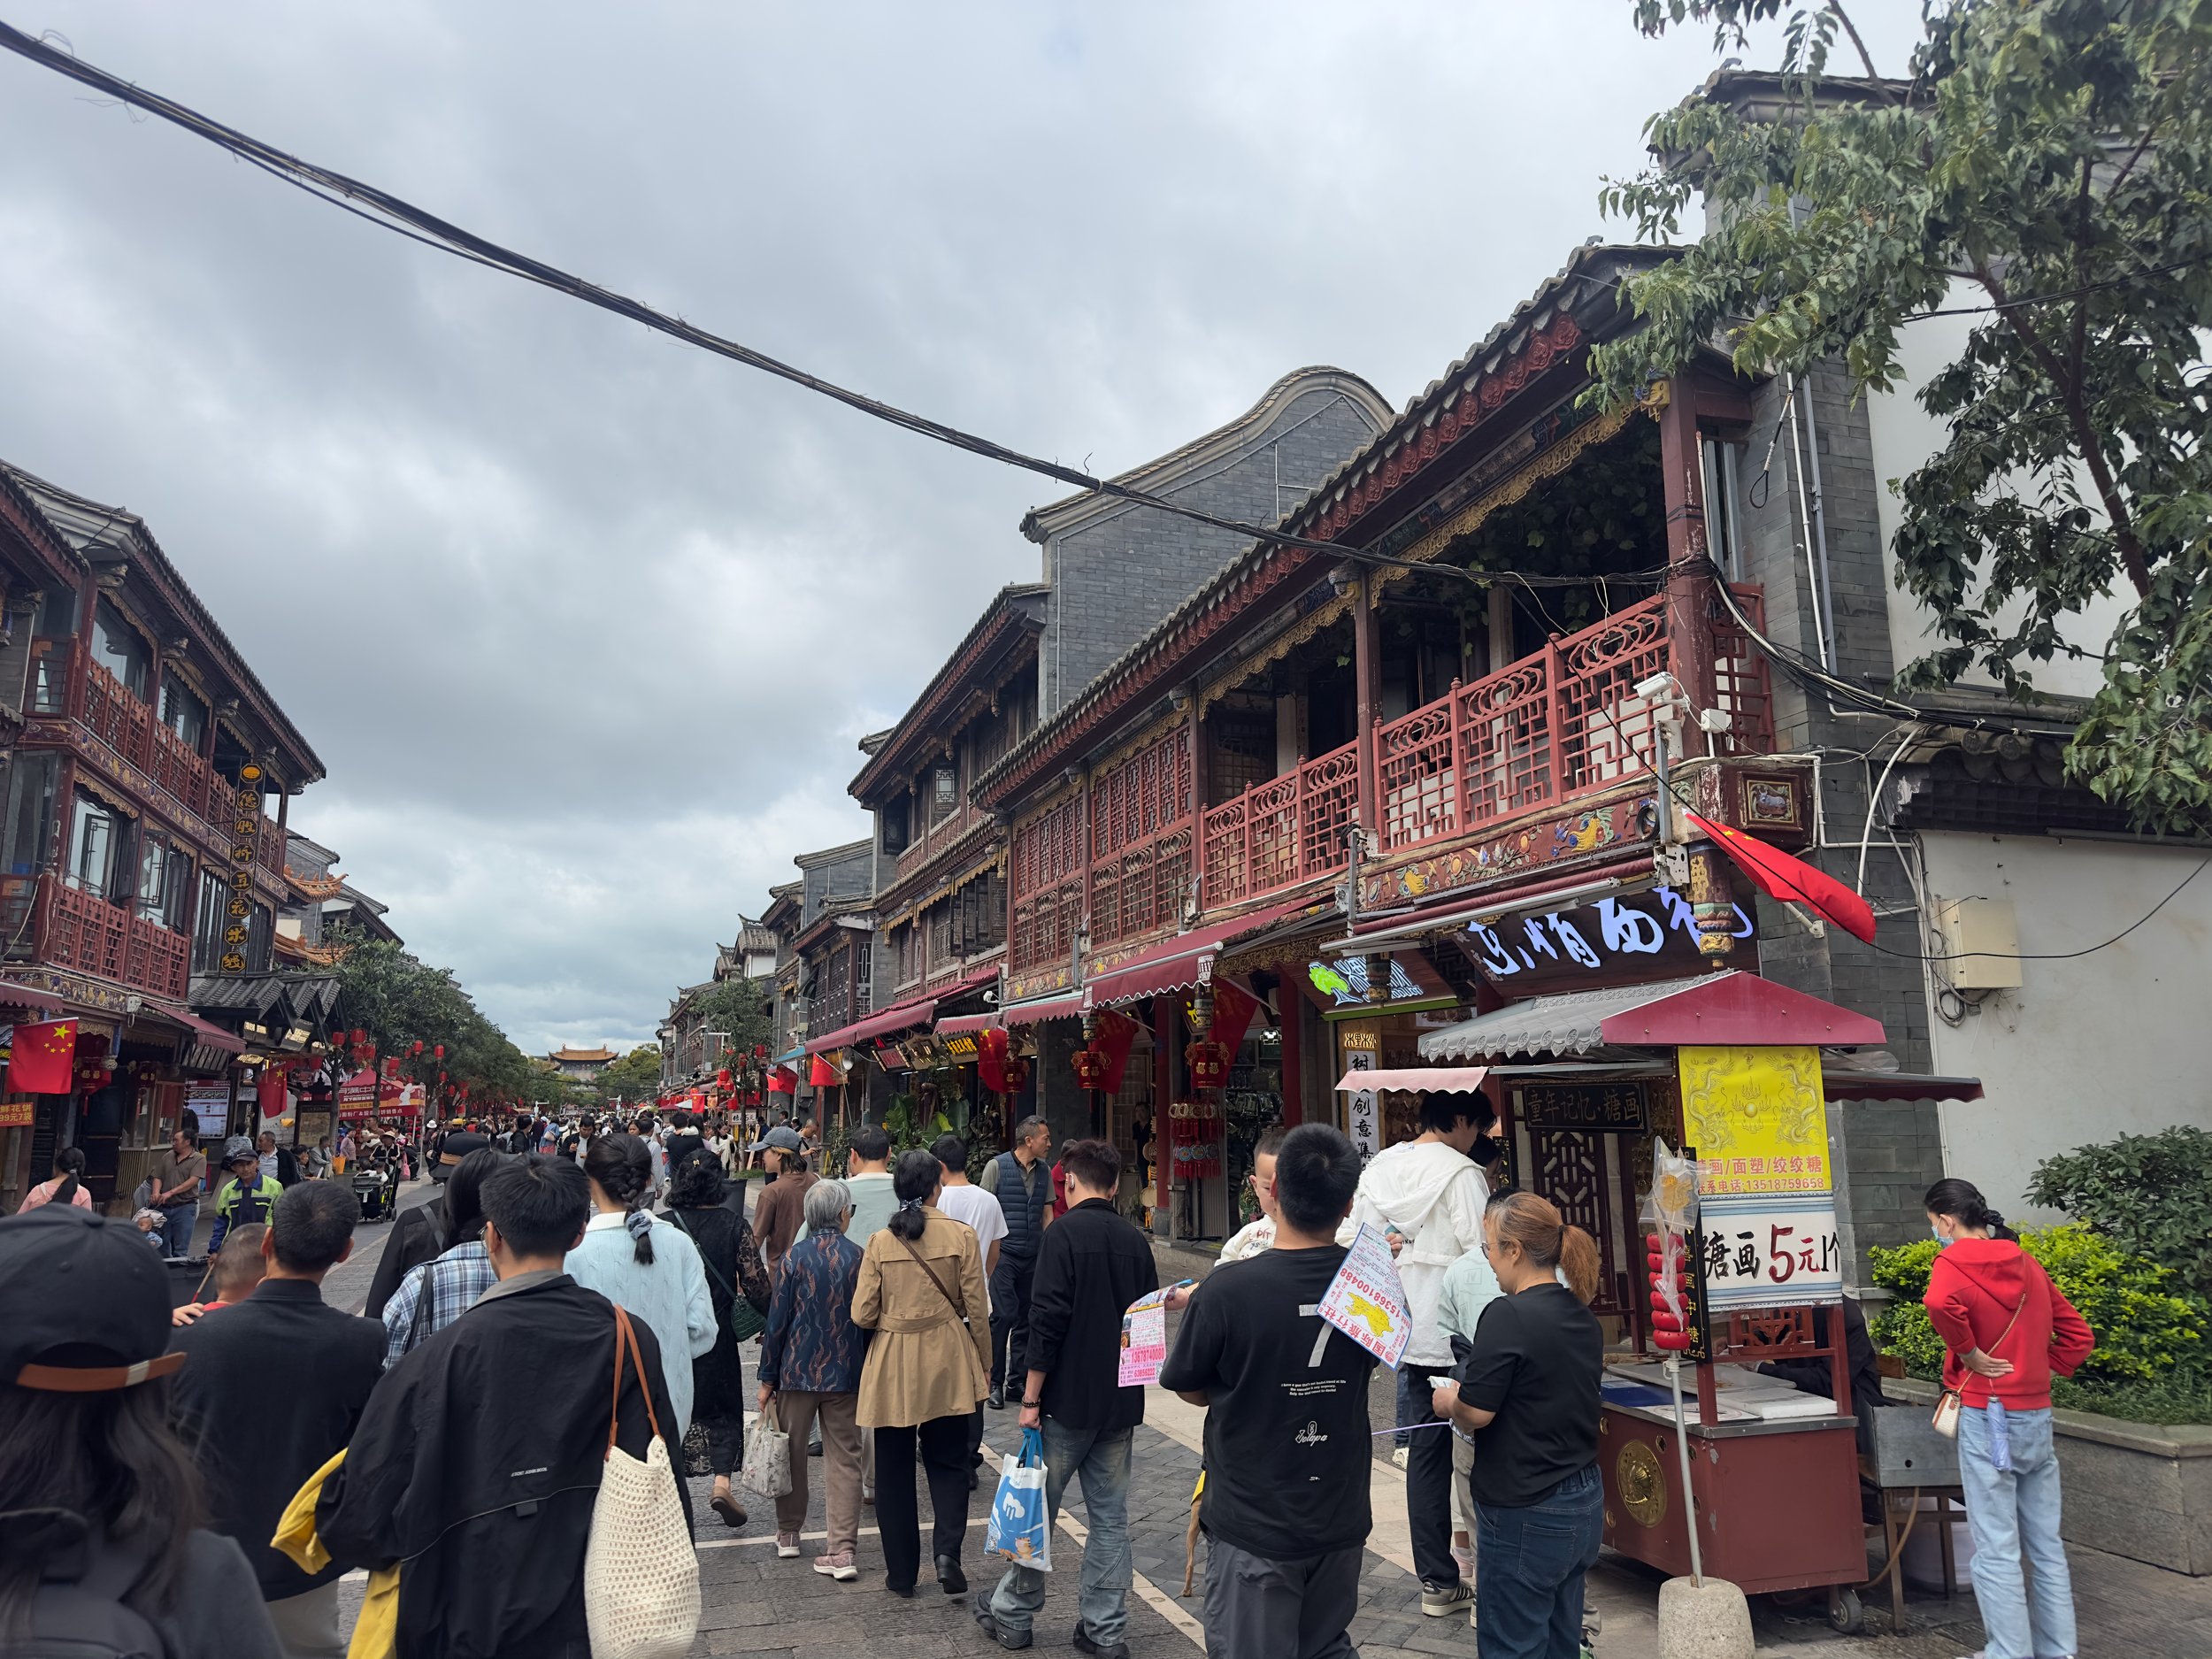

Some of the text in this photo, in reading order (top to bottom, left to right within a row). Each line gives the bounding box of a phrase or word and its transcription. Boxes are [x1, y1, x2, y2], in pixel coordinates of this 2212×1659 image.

[1340, 1268, 1401, 1318] 15368100488
[1325, 1305, 1386, 1357] 国际旅行社
